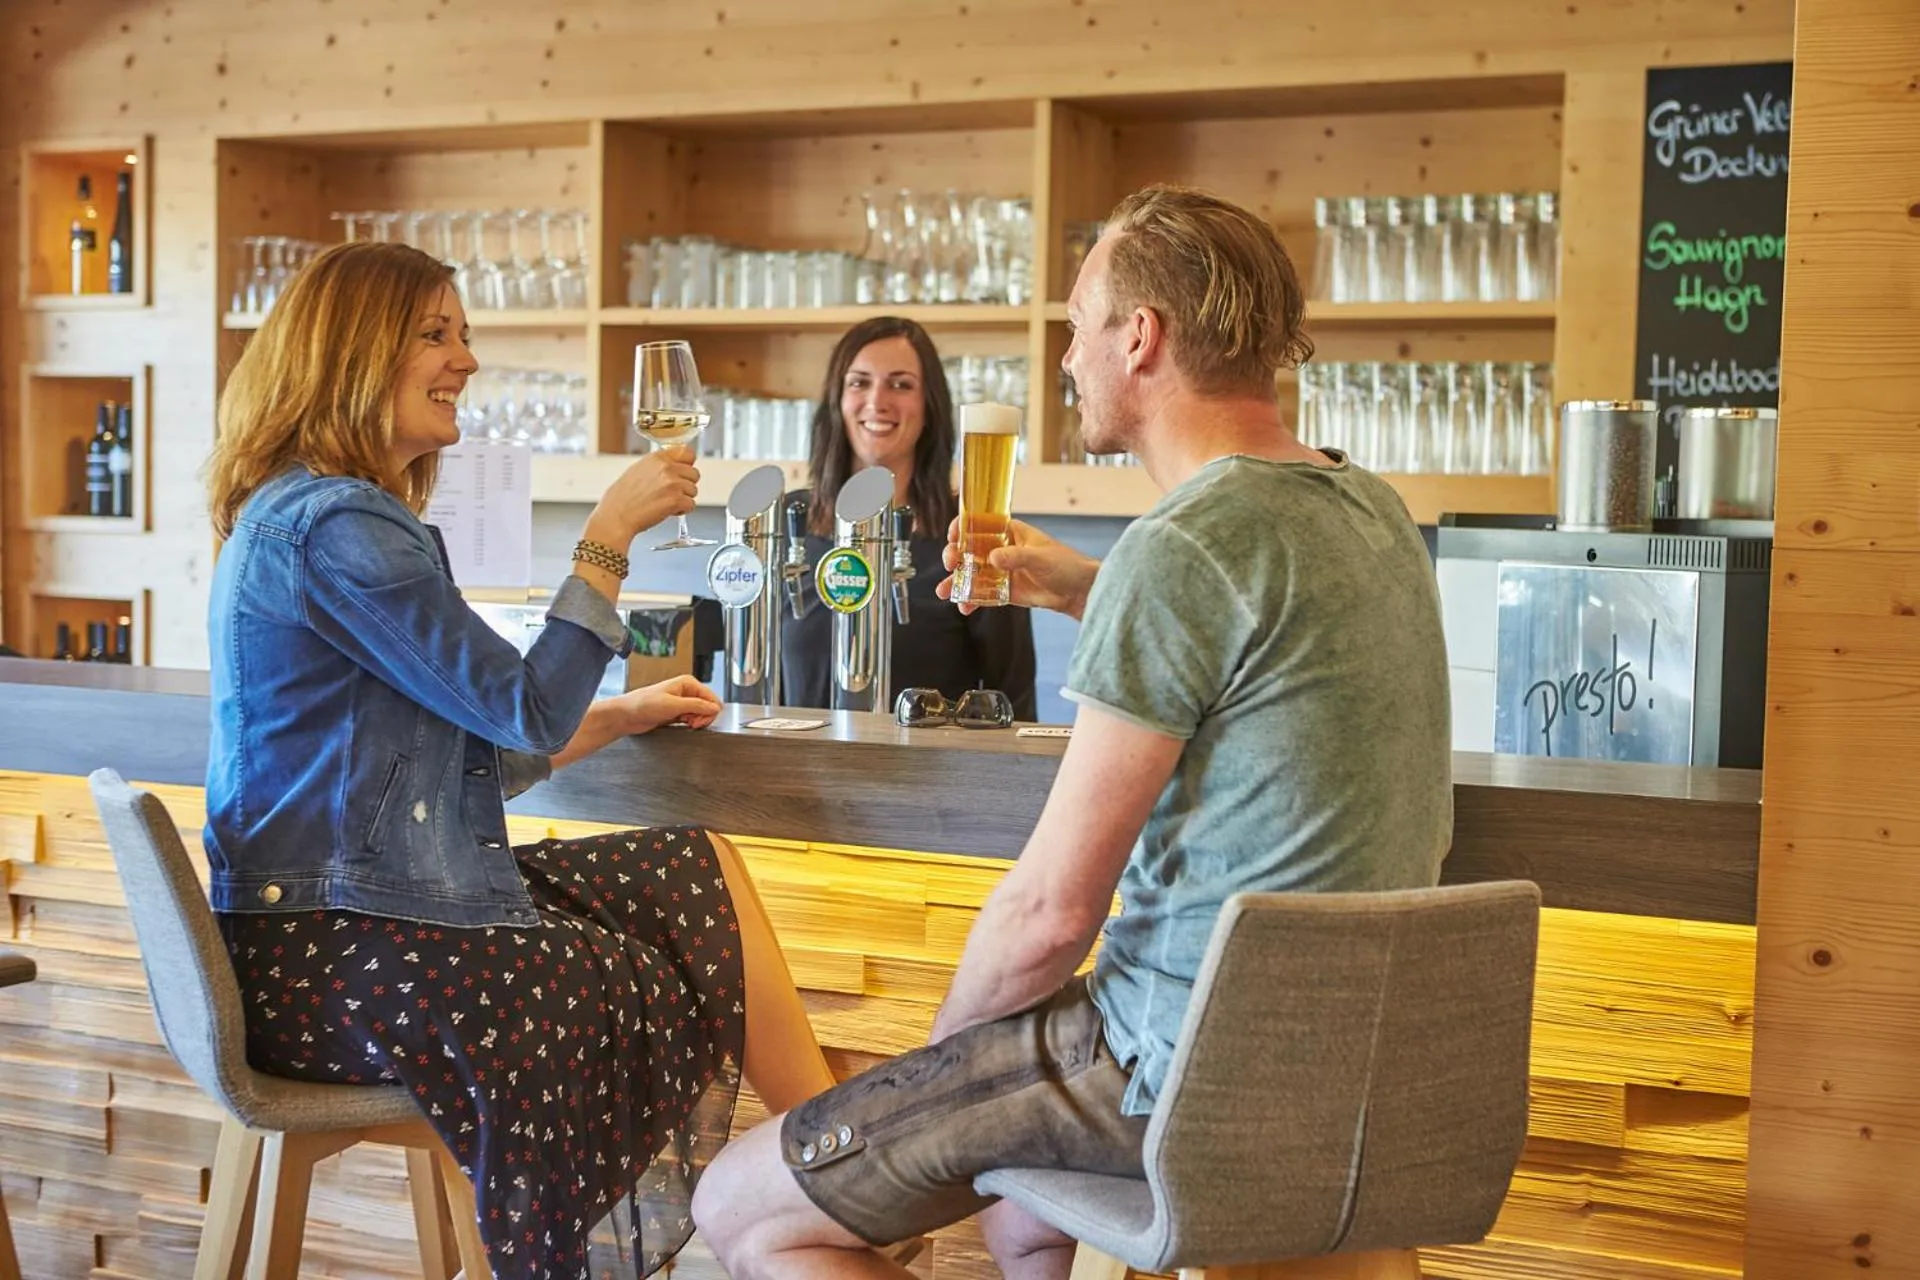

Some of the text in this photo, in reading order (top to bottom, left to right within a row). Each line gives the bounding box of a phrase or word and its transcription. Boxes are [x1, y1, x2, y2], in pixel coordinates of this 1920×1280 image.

[1673, 273, 1768, 334] Hagn
[716, 566, 759, 584] Zipfer
[1523, 618, 1657, 757] presto!
